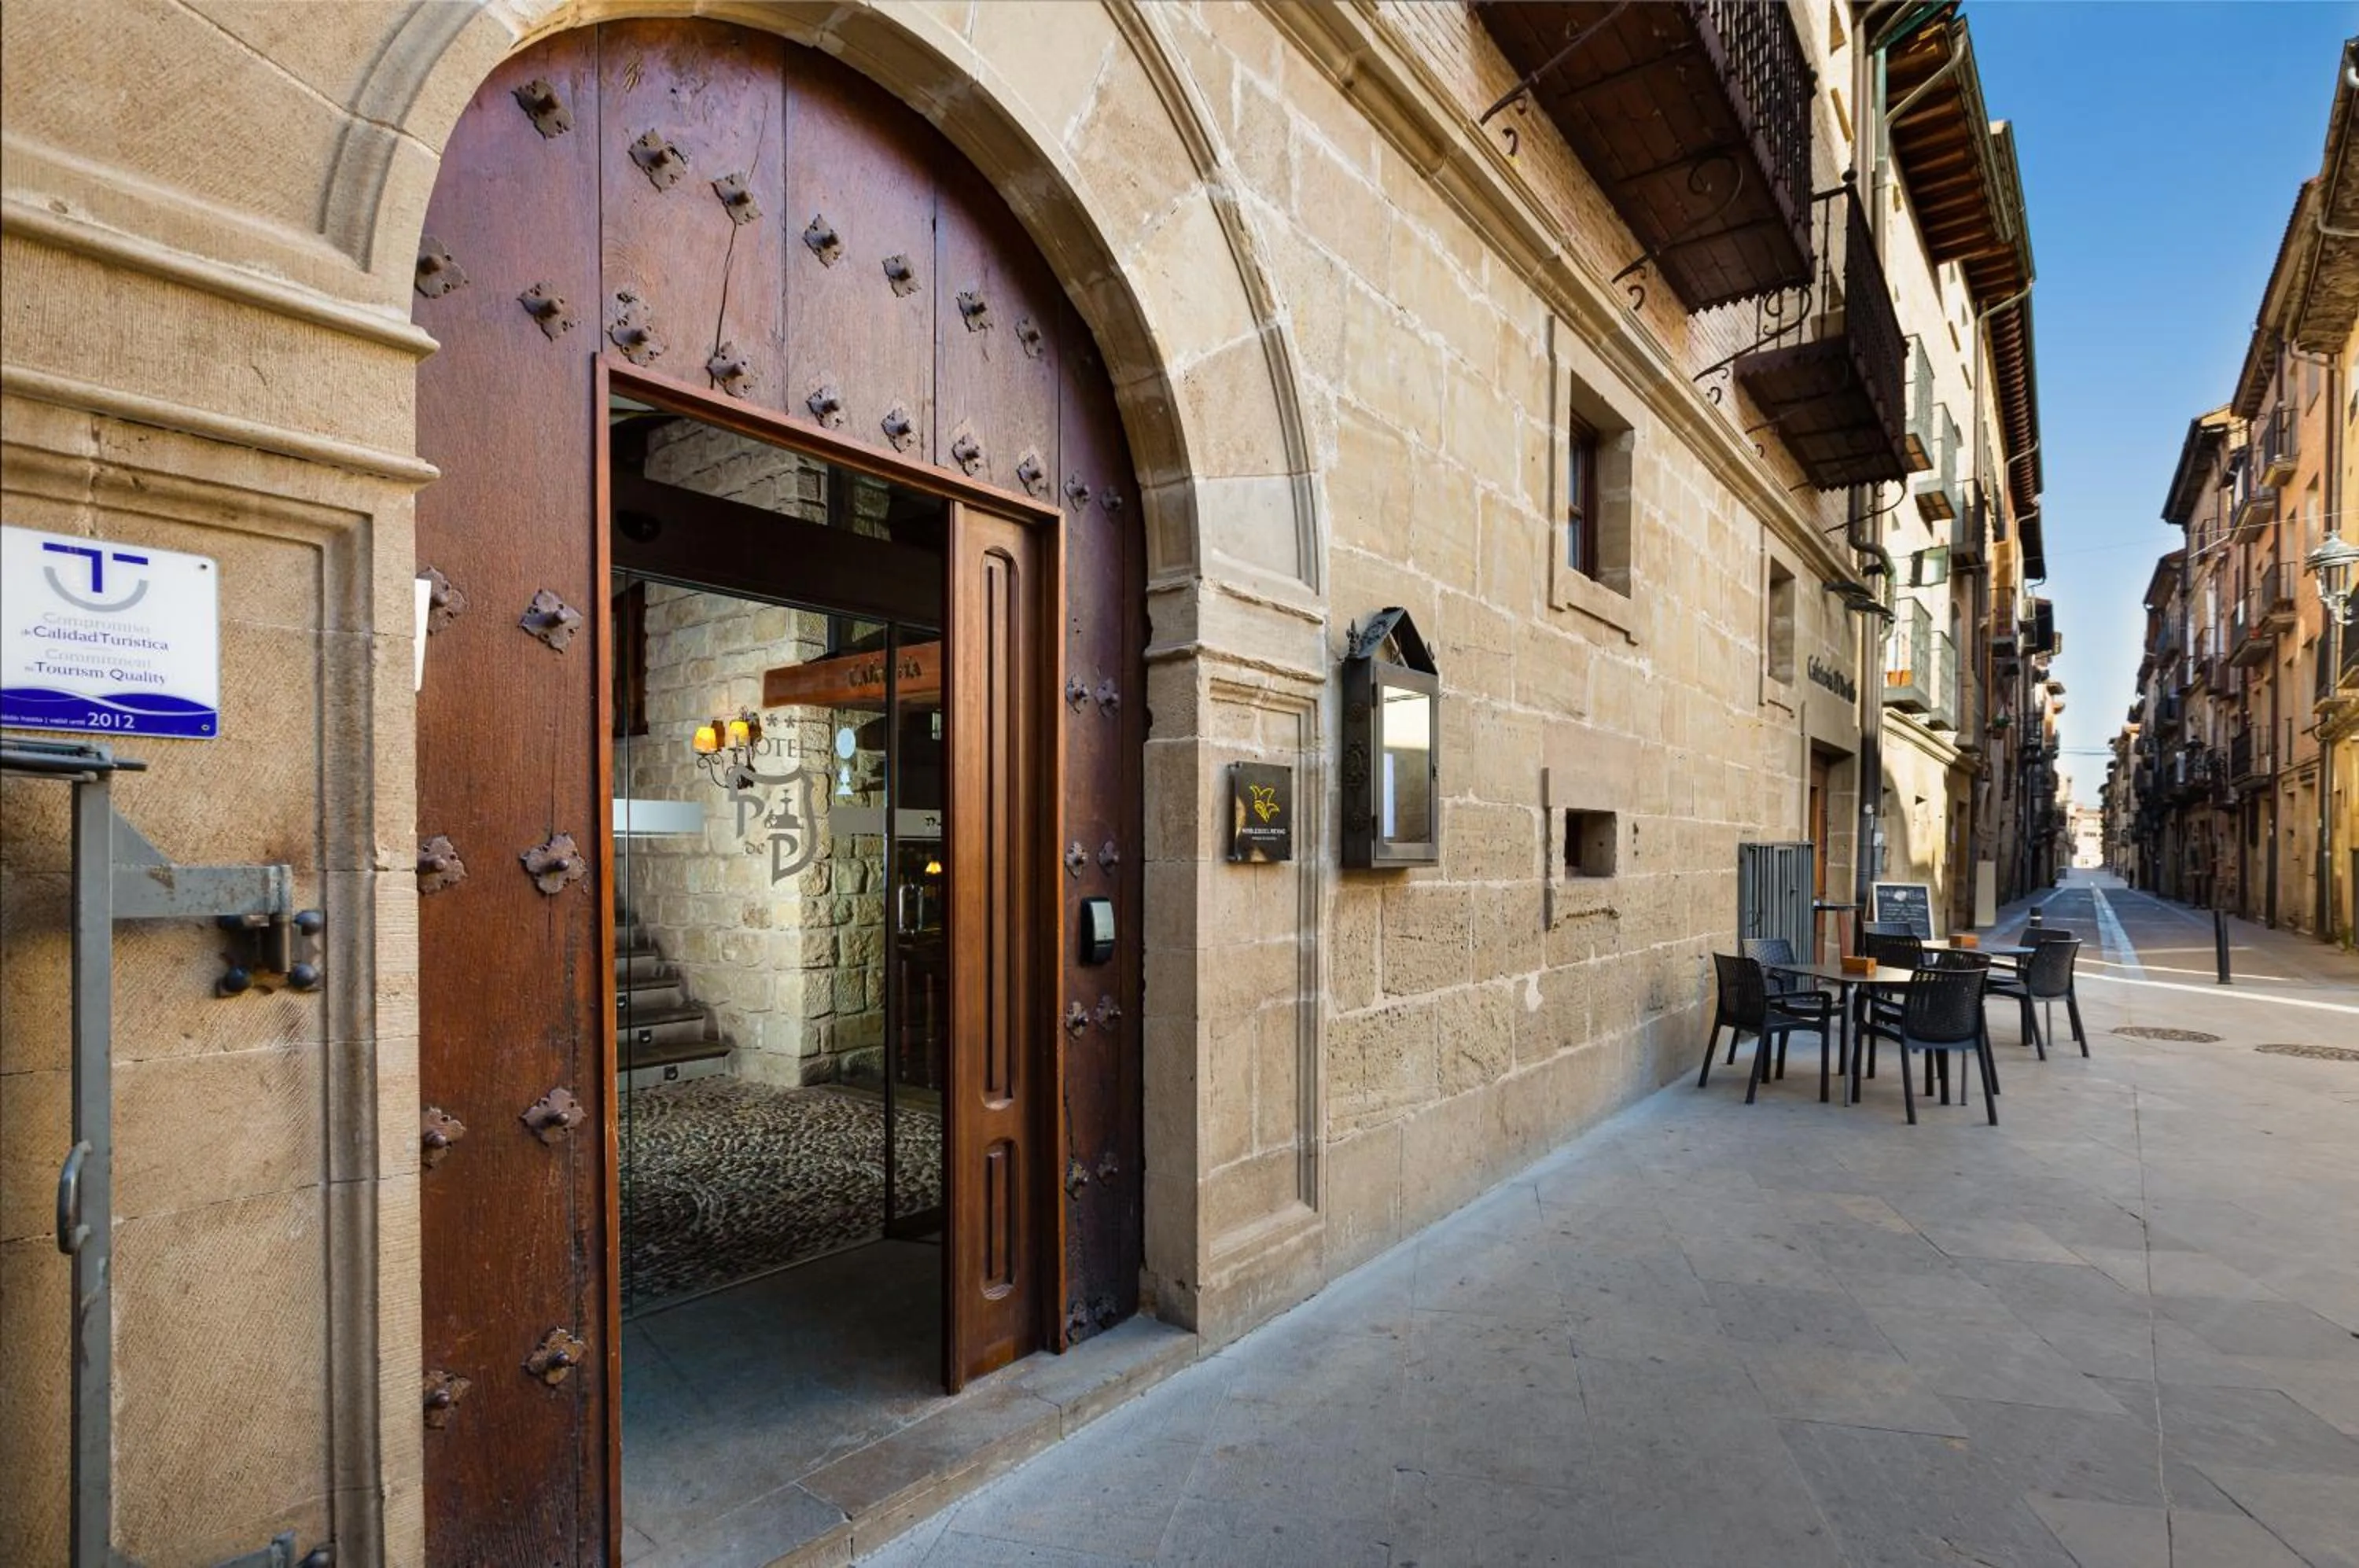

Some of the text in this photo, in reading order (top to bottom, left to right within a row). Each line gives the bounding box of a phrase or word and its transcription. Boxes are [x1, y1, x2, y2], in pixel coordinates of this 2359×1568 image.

[33, 624, 98, 644] Calidad
[42, 611, 151, 635] Compromiso
[44, 647, 152, 669] Commitment
[34, 661, 105, 679] Tourism
[109, 667, 166, 685] Quality
[87, 712, 135, 730] 2012
